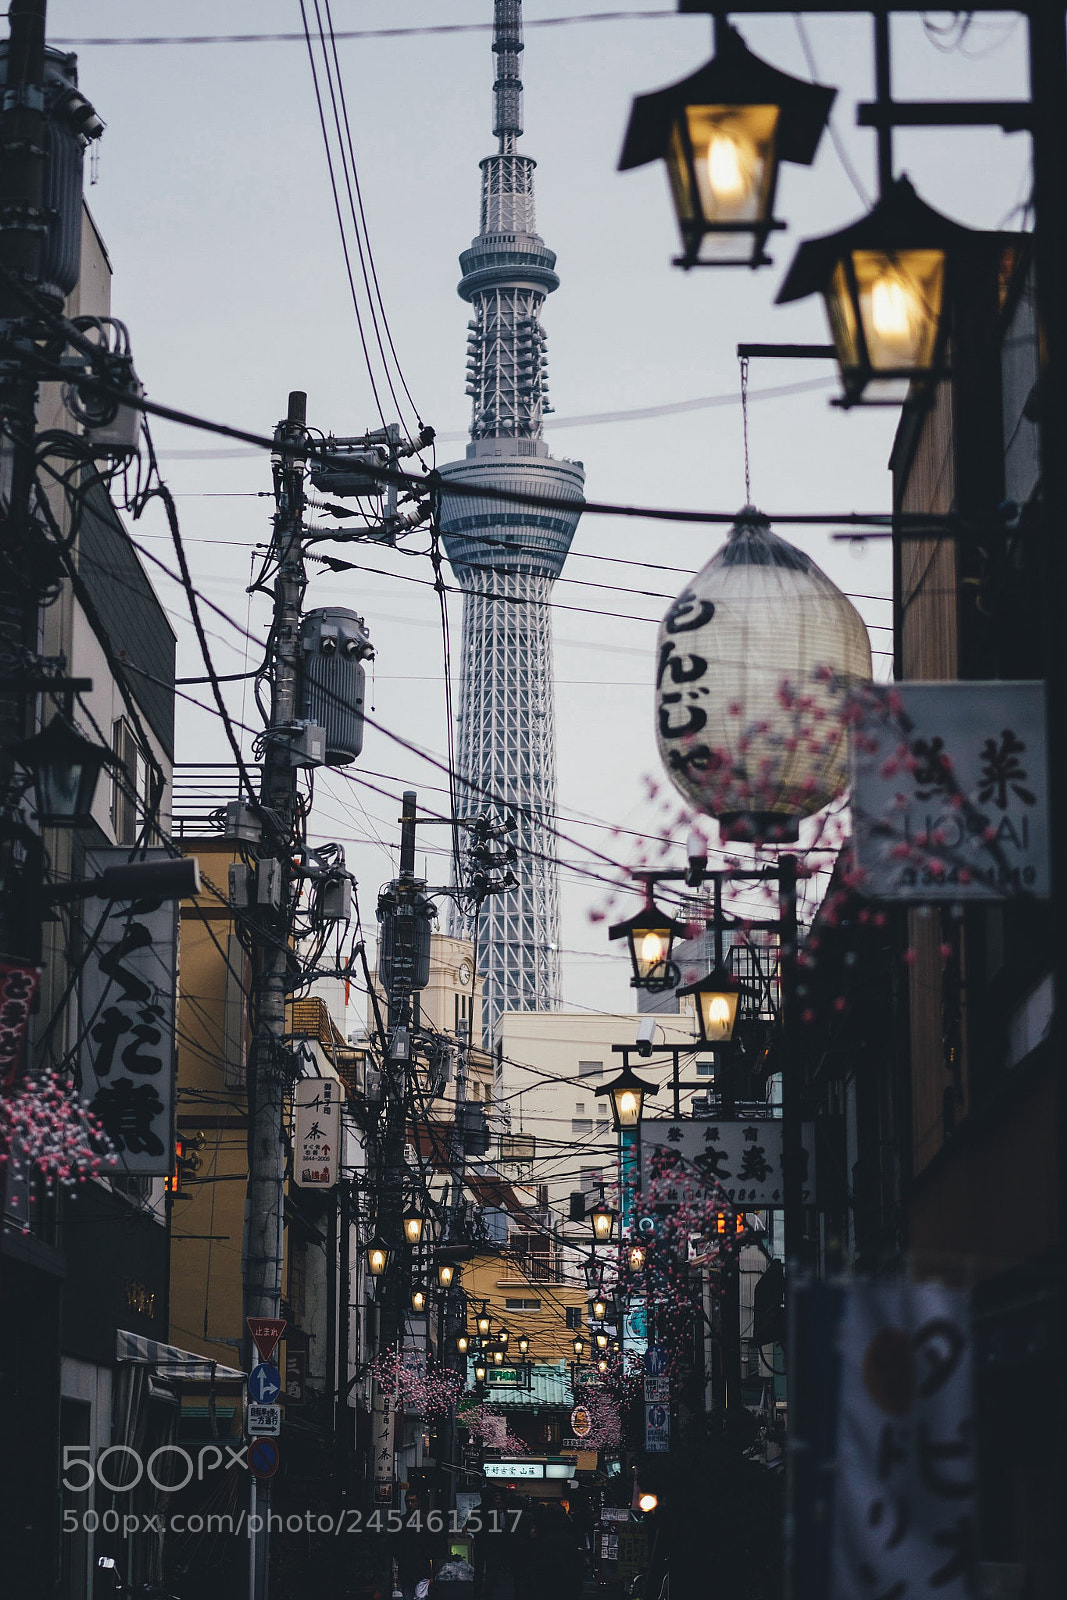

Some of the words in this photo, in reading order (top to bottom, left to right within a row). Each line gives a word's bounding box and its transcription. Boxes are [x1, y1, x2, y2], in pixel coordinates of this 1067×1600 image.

[656, 588, 717, 784] もんじゃ
[255, 1326, 279, 1337] 止まれ
[250, 1416, 278, 1425] 一方通行
